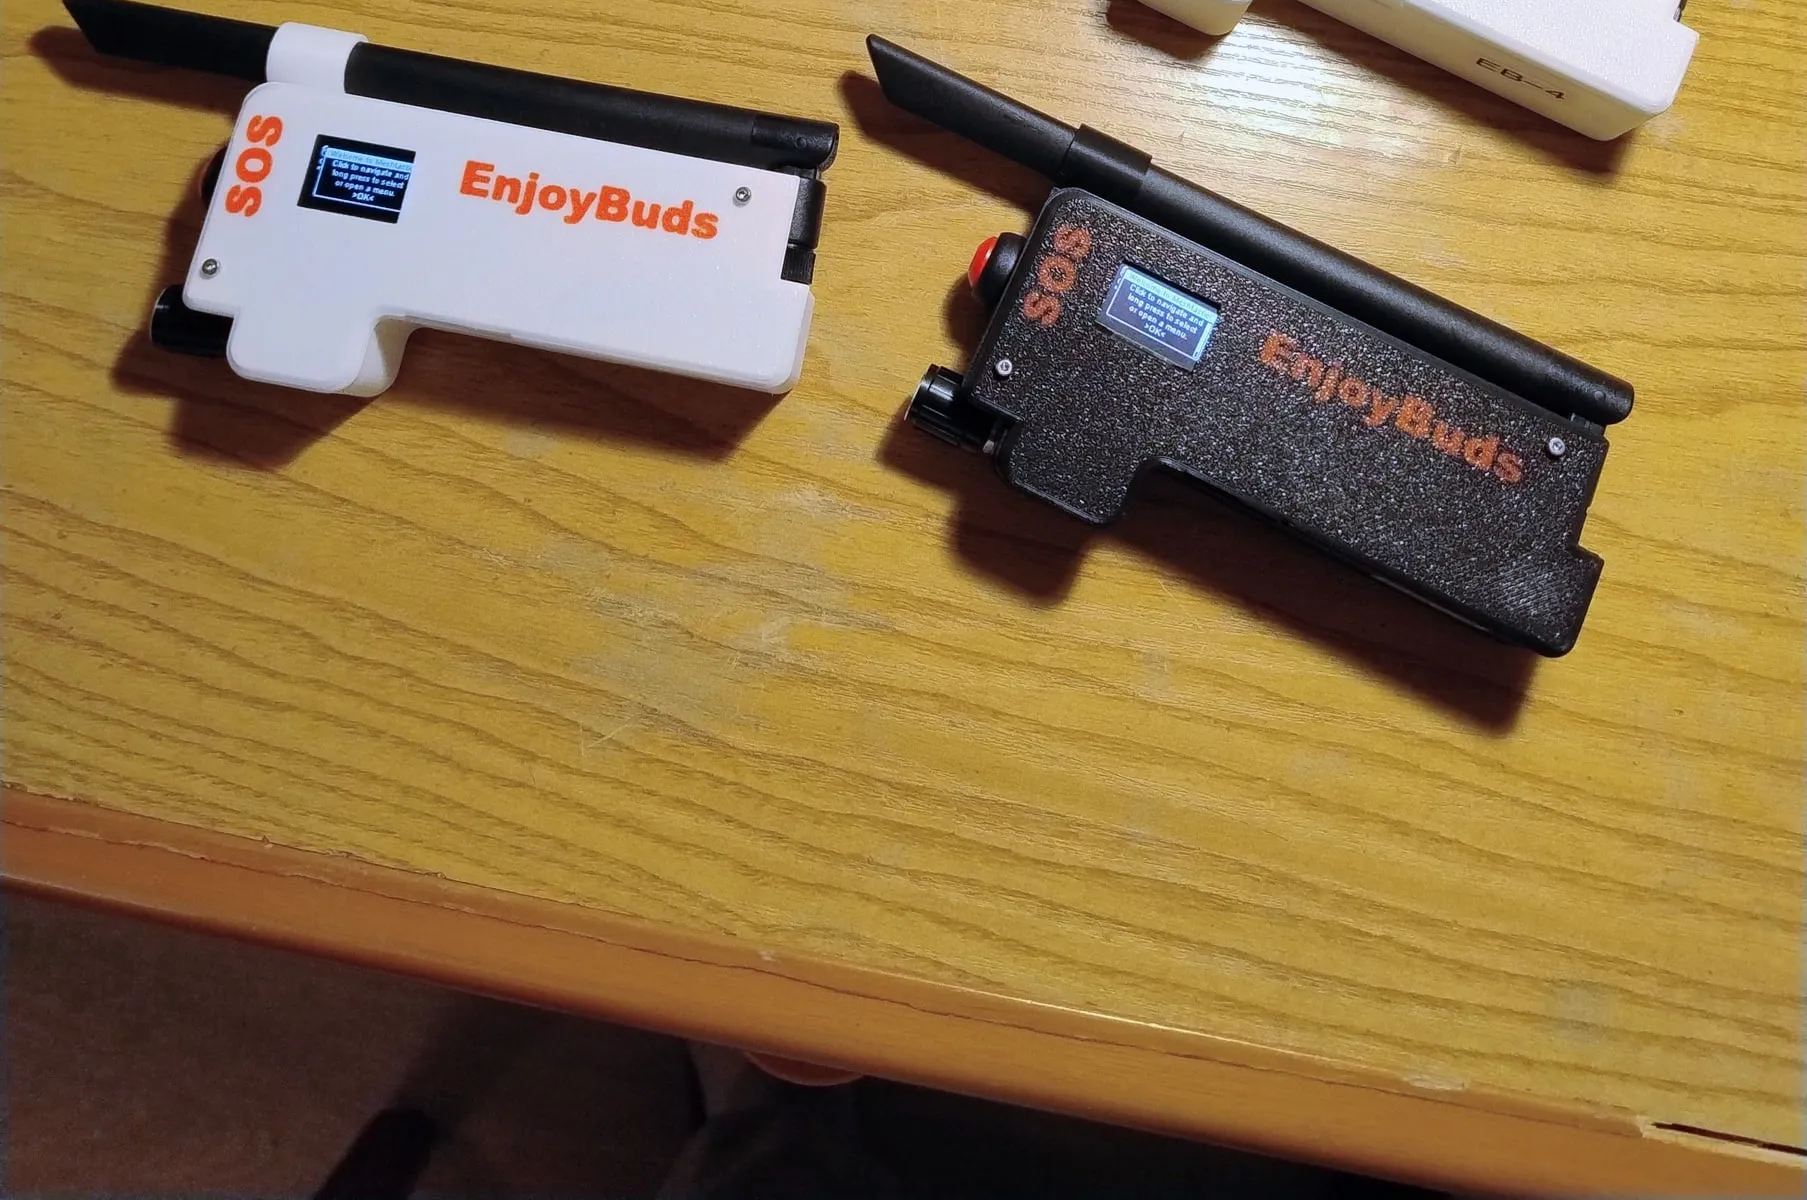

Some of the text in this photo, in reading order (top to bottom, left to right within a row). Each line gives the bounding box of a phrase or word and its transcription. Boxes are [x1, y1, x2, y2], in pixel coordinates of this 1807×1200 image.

[1476, 57, 1565, 99] EB-4
[224, 114, 285, 218] SOS
[332, 160, 410, 181] Click to navigate and
[332, 169, 405, 189] long press to select
[344, 182, 364, 191] open
[372, 187, 395, 197] menu.
[459, 160, 720, 241] EnjoyBuds
[1022, 223, 1091, 329] SOS
[1128, 293, 1198, 334] long press to select
[1129, 284, 1205, 327] Click to navigate and
[1129, 305, 1138, 314] or
[1138, 310, 1157, 324] open
[1165, 324, 1188, 340] menu.
[1258, 331, 1526, 484] EnjoyBuds
